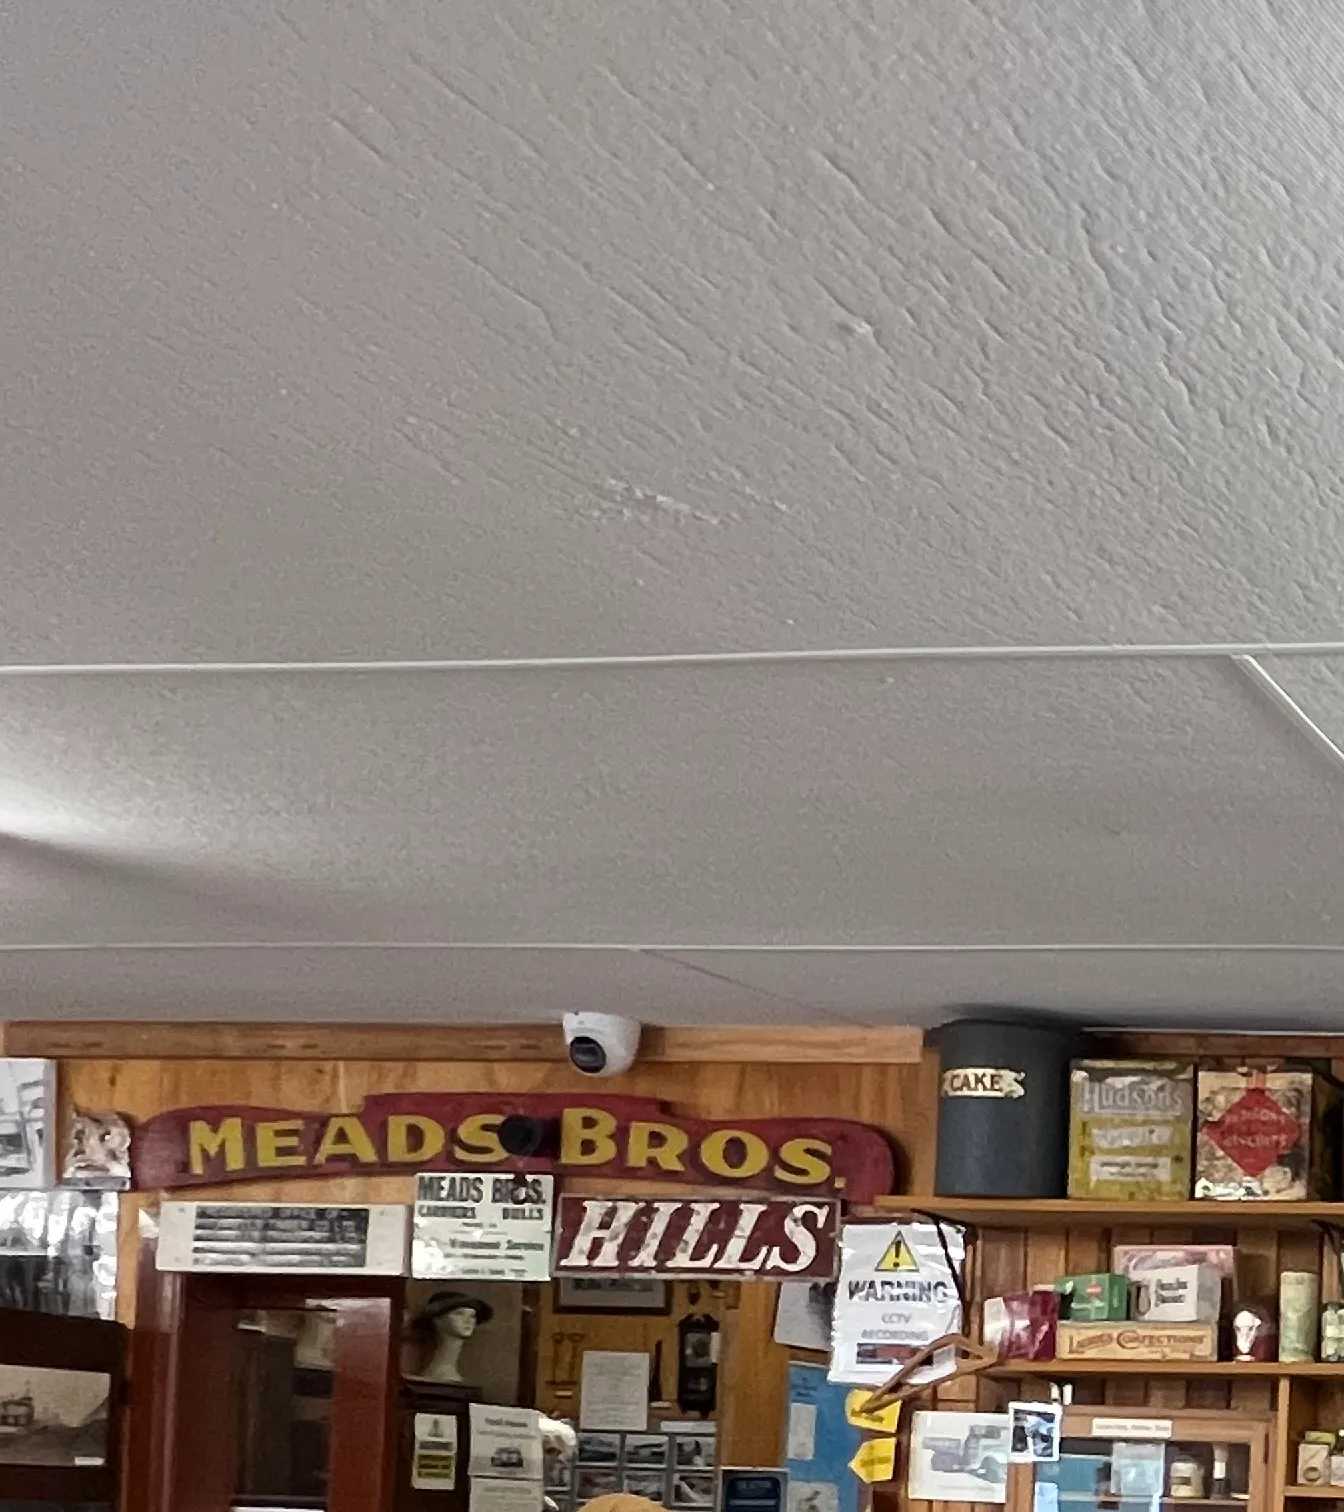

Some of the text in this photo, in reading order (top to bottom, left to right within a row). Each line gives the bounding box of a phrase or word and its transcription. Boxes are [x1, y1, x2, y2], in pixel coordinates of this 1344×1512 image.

[949, 1073, 1004, 1093] CAKE
[188, 1107, 848, 1189] MEADS BROS.
[418, 1176, 484, 1203] MEADS
[559, 1200, 830, 1272] HILLS
[848, 1280, 949, 1303] WARNING
[881, 1312, 912, 1325] CCTV
